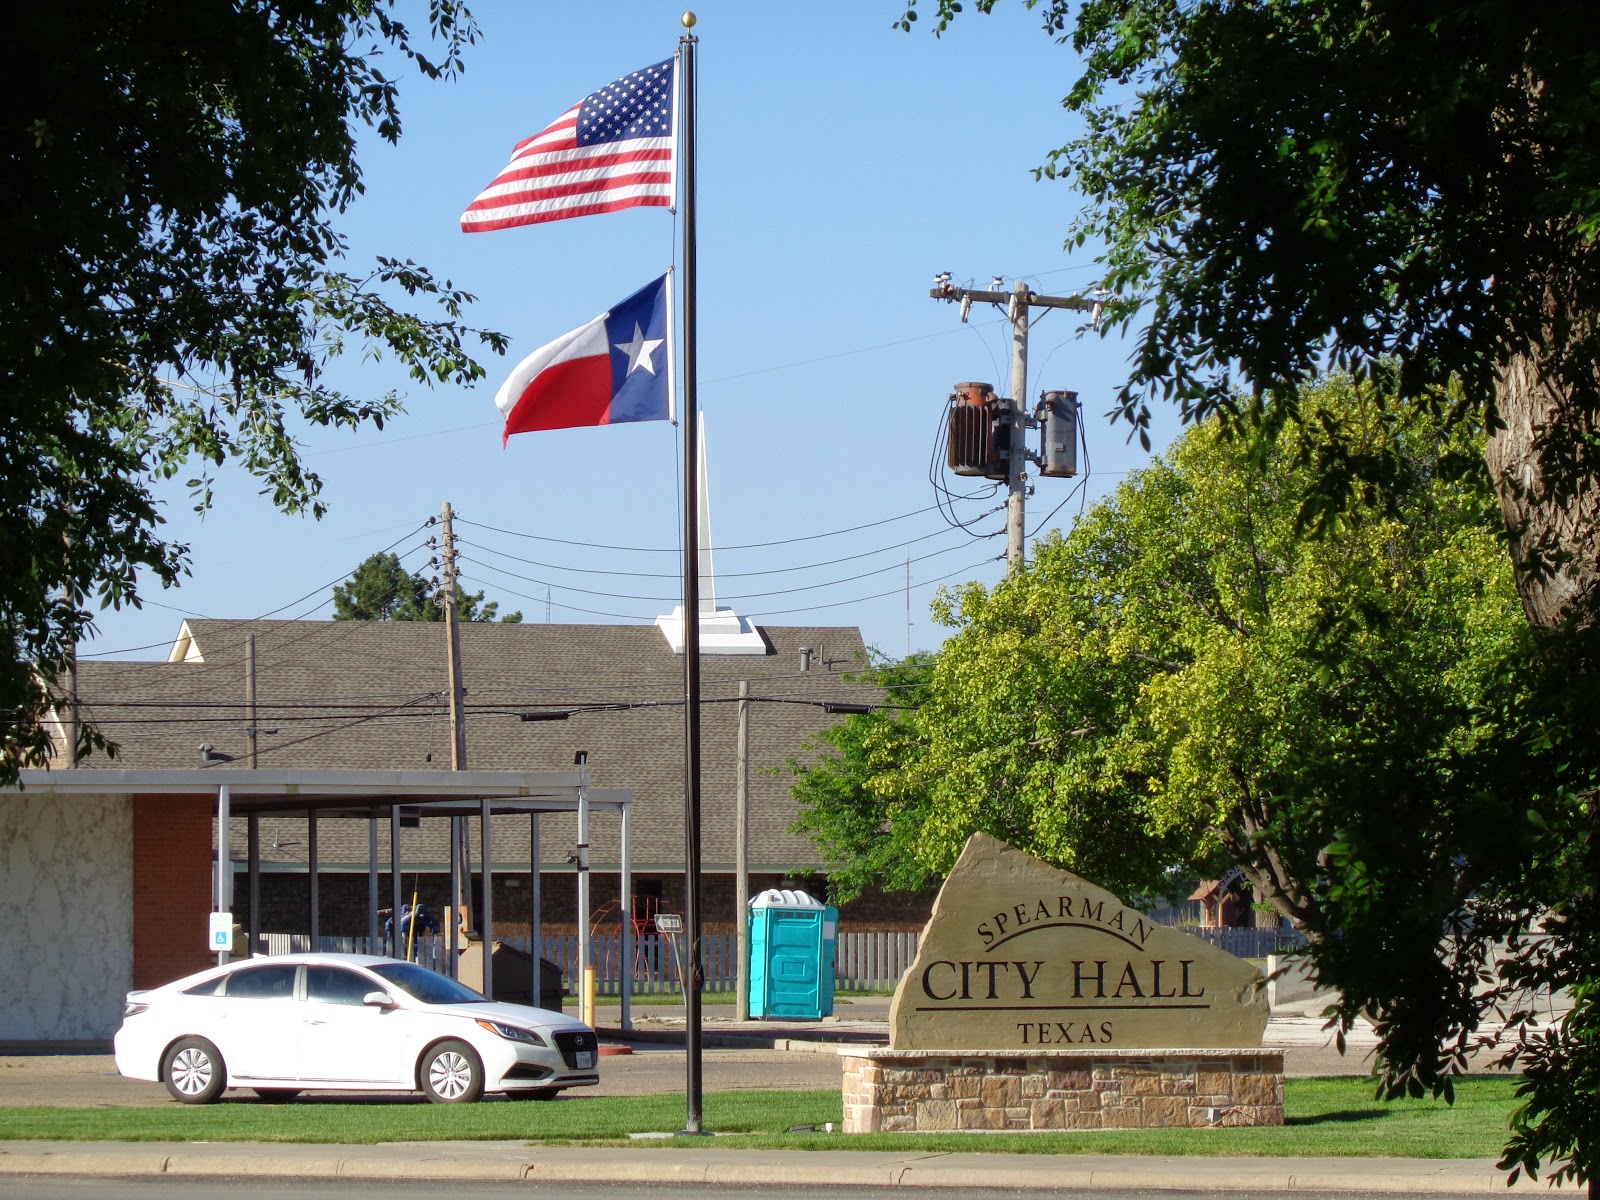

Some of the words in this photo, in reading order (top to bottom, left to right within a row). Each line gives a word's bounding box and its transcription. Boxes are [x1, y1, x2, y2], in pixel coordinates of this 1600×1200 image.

[977, 896, 1154, 945] SPEARMAN
[921, 960, 1045, 1000] CITY
[1070, 960, 1205, 999] HALL
[1016, 1021, 1113, 1044] TEXAS
